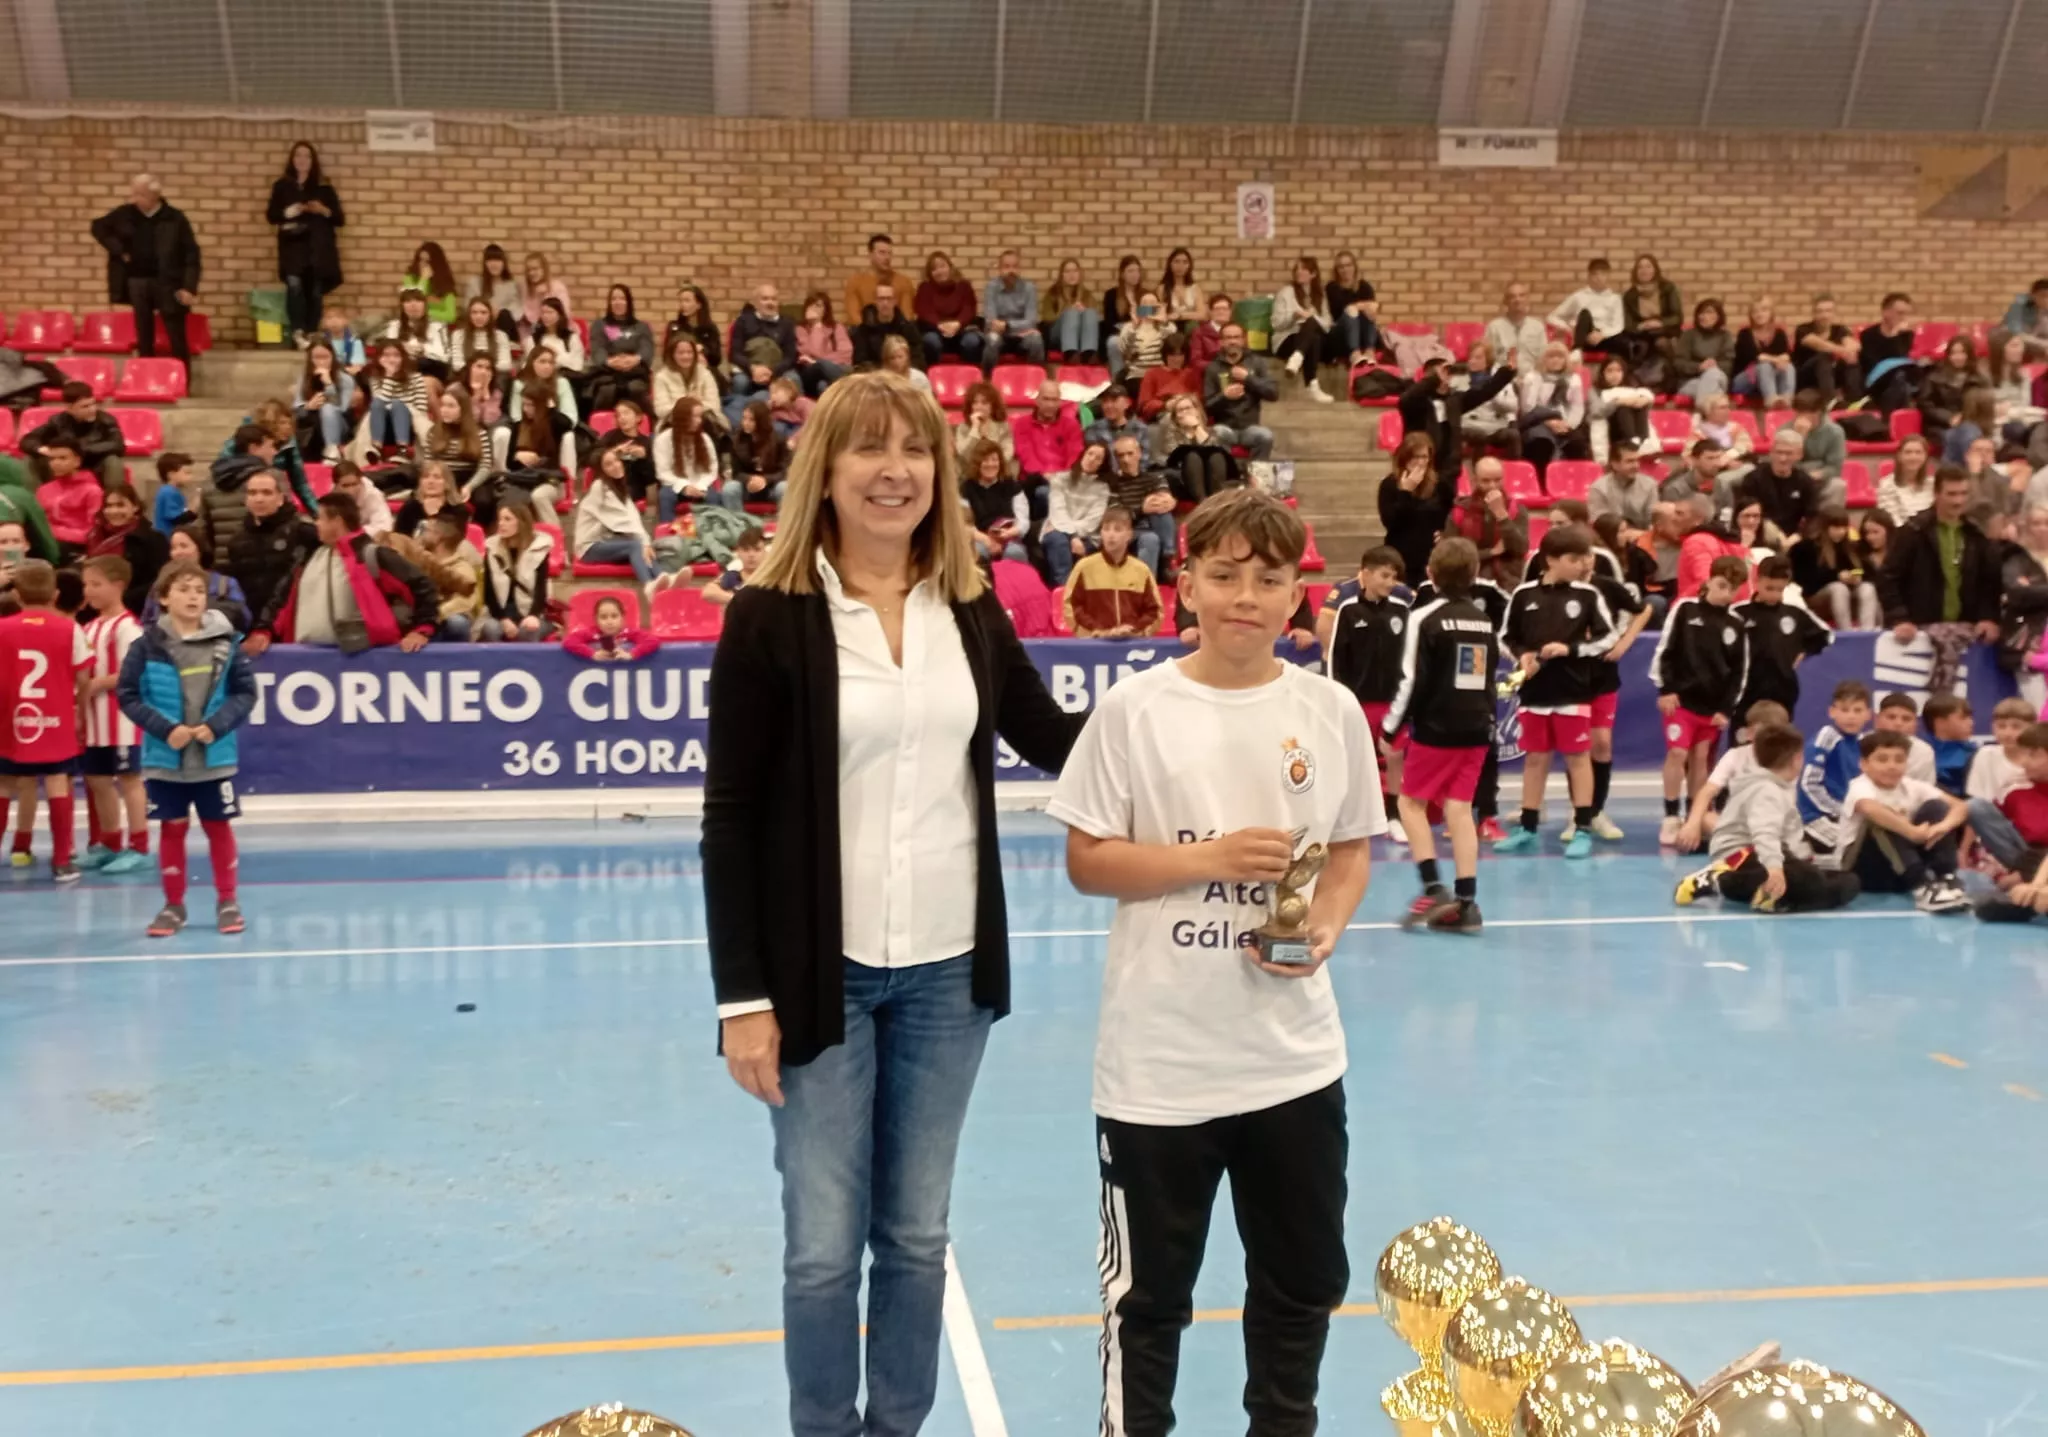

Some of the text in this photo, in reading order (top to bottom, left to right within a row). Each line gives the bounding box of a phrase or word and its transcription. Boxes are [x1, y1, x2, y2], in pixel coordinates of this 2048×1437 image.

[18, 649, 48, 699] 2
[249, 669, 543, 725] TORNEO
[503, 740, 561, 776] 36
